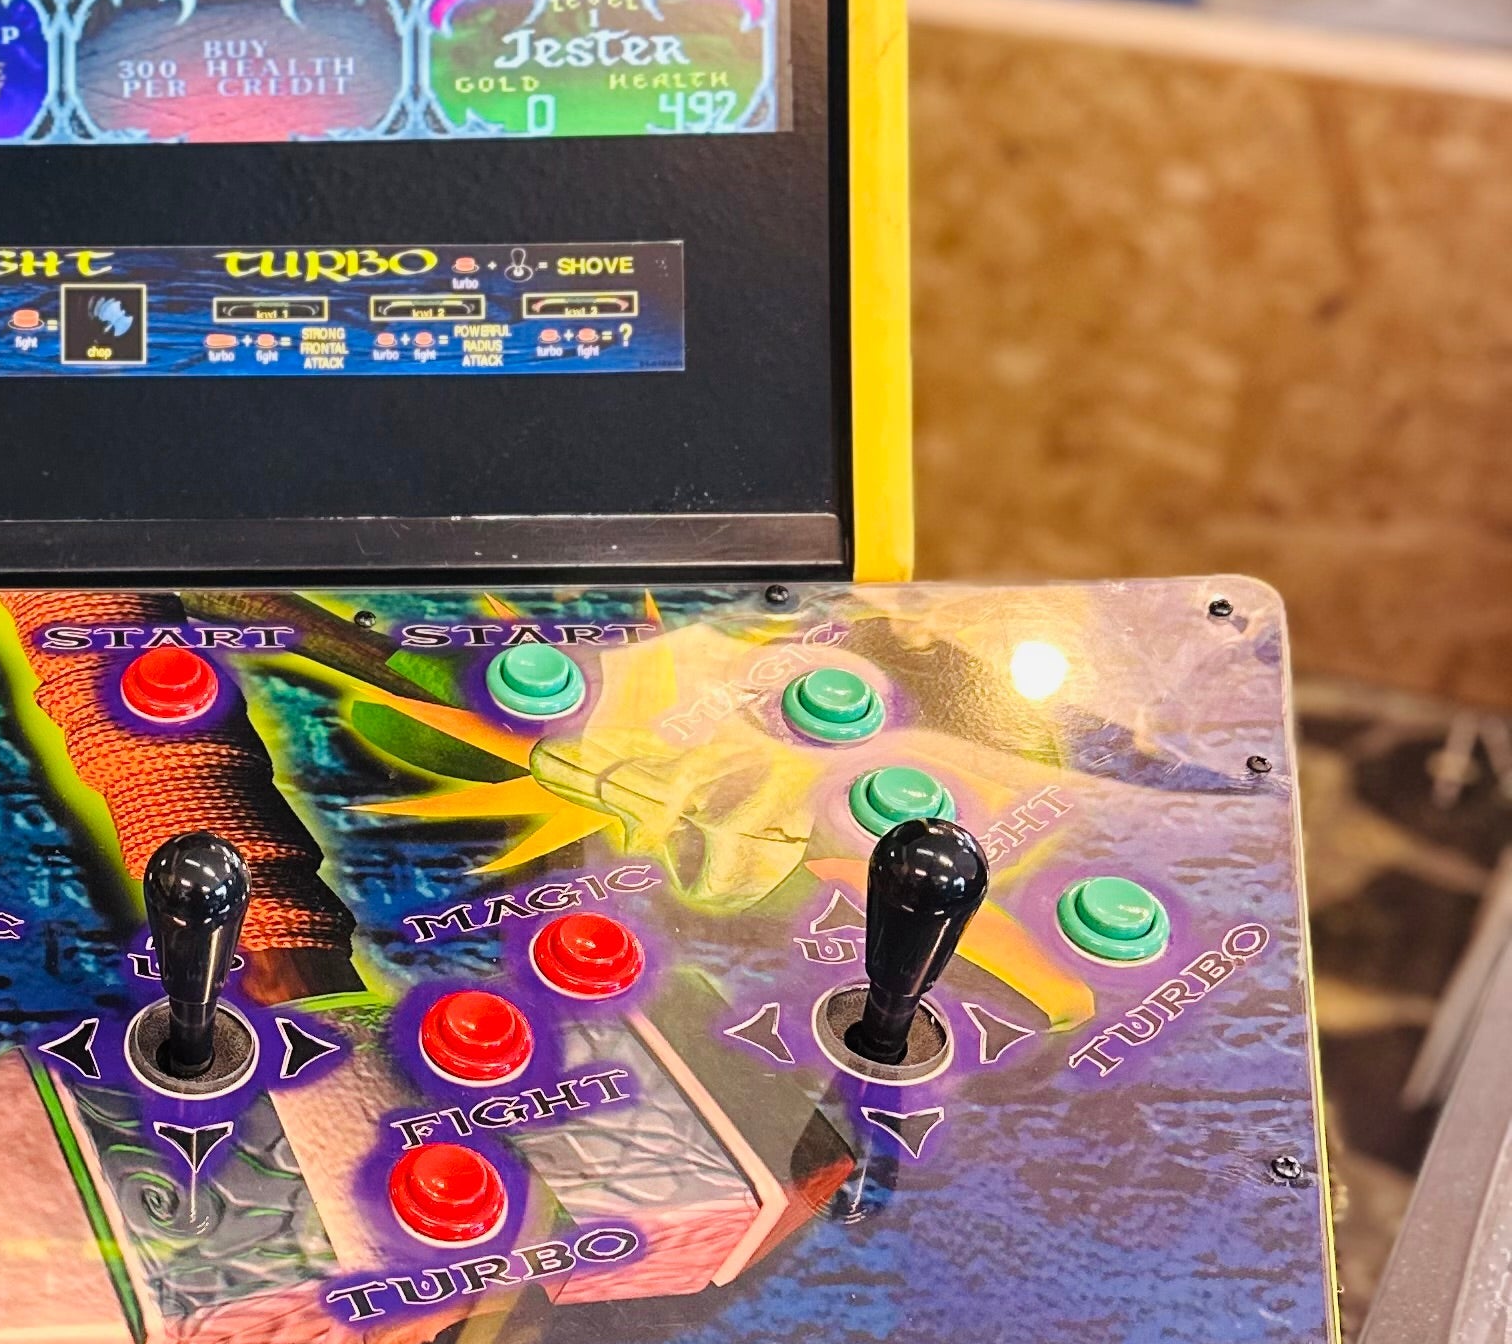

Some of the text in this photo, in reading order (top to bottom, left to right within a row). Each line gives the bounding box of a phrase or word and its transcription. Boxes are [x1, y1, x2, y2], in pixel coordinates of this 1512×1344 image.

[203, 40, 268, 59] BUY
[118, 57, 354, 80] 300 HEALTH
[122, 77, 351, 98] PER CREDIT
[455, 72, 728, 93] GOLD HEALTH
[526, 90, 737, 134] 0 492
[214, 248, 438, 283] TURBO
[557, 256, 635, 275] SHOVE
[452, 277, 478, 289] turbo
[301, 327, 345, 340] STRONG
[454, 324, 512, 337] POWERFUL
[619, 322, 633, 347] ?
[15, 336, 39, 350] fight
[87, 346, 112, 360] chop
[300, 342, 349, 355] FRONTAL
[462, 339, 503, 352] RADIUS
[536, 345, 600, 359] turbo fight
[208, 350, 278, 364] turbo fight
[304, 356, 345, 369] ATTACK
[373, 350, 436, 363] turbo fight
[462, 354, 504, 367] ATTACK
[42, 626, 295, 650] START
[401, 624, 656, 648] START
[977, 785, 1075, 865] GHT
[403, 864, 663, 943] MAGIC
[792, 937, 866, 964] U
[1069, 923, 1271, 1078] TURBO
[390, 1068, 633, 1151] FIGHT
[327, 1228, 641, 1324] TURBO
